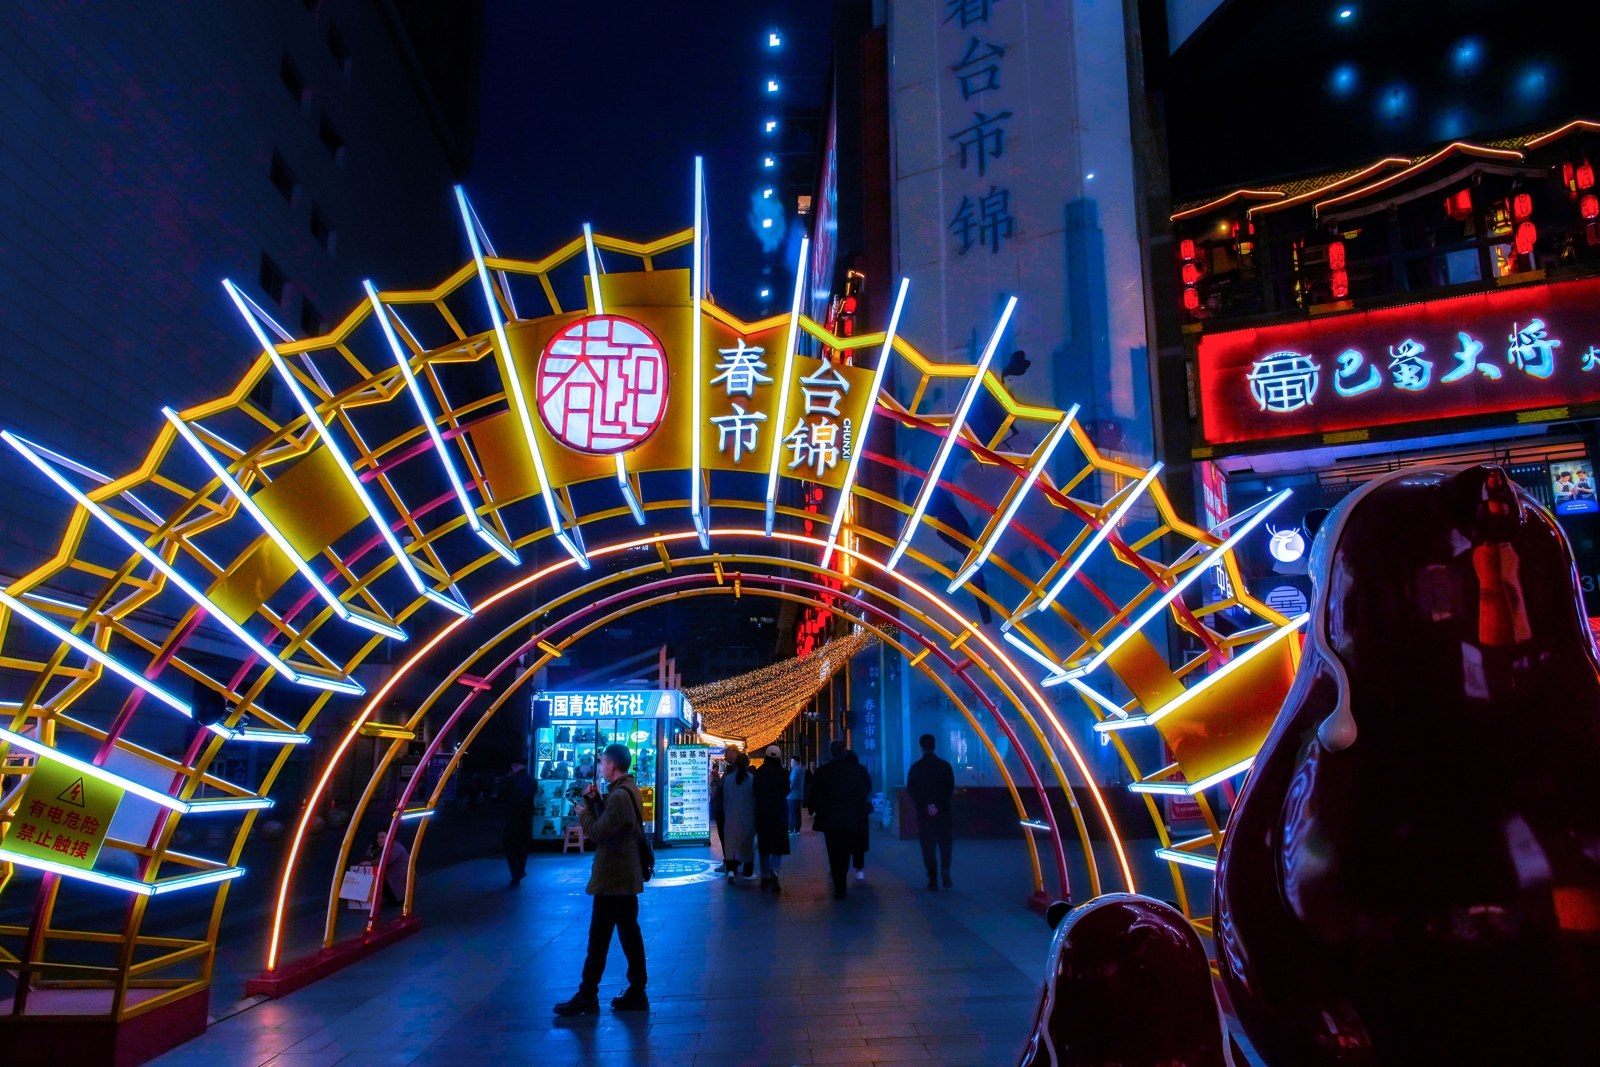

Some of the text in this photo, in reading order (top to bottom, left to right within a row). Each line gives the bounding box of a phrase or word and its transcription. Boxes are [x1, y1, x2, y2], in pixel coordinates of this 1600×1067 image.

[1334, 318, 1560, 398] 巴蜀大将
[842, 417, 852, 460] CHUNXI
[29, 799, 100, 836] 有电危险
[16, 822, 91, 860] 禁止触摸
